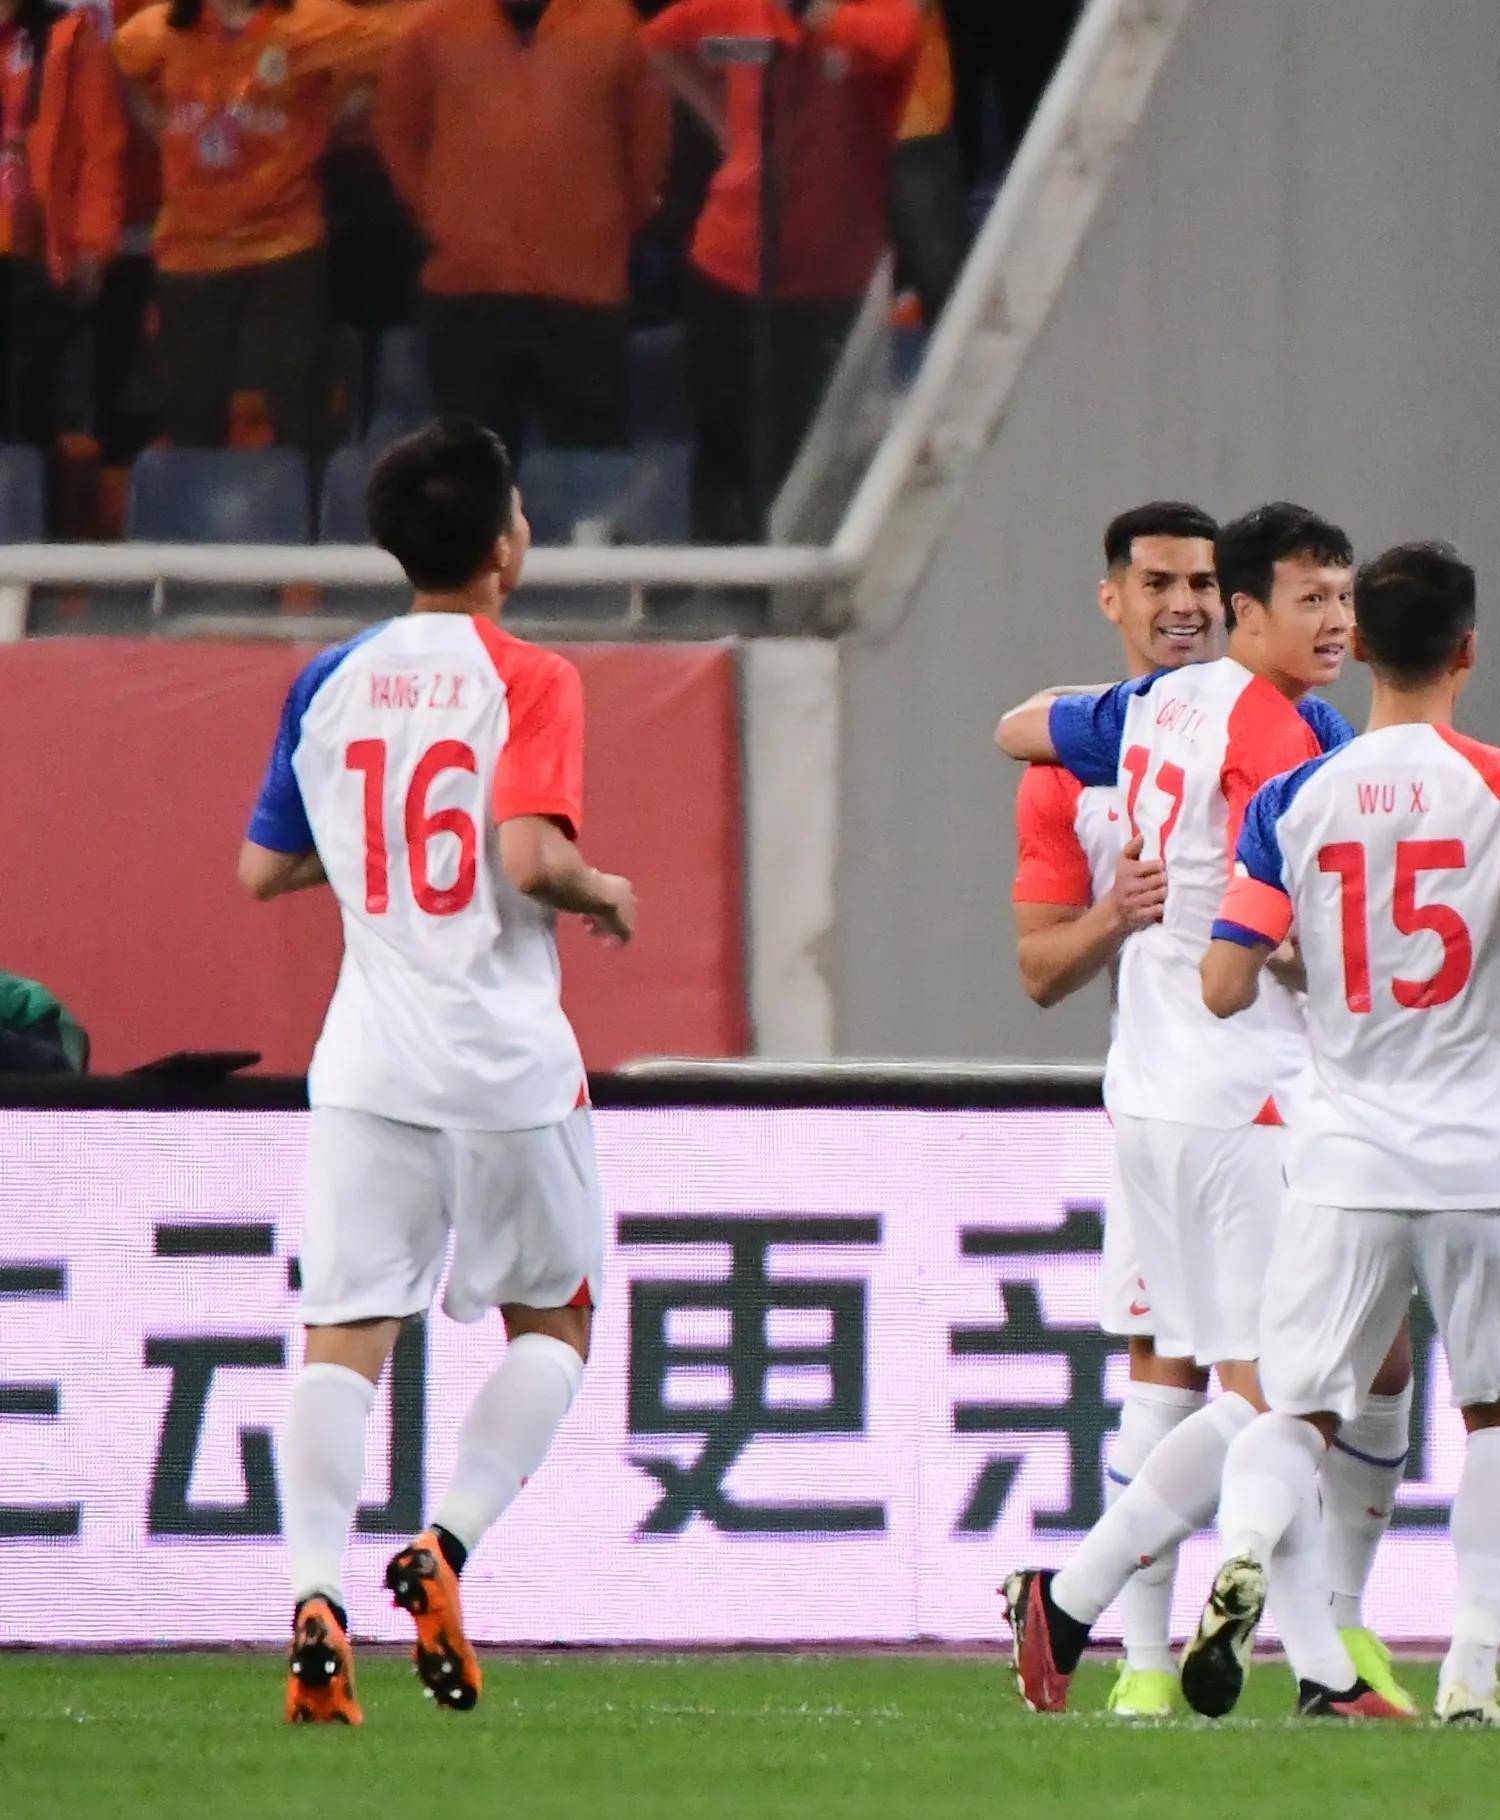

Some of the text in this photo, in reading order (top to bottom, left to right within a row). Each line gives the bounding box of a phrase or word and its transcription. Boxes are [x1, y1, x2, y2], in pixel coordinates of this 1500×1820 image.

[370, 672, 419, 709] YANG
[346, 739, 477, 915] 16
[1358, 783, 1395, 815] WU
[1318, 838, 1472, 1013] 15
